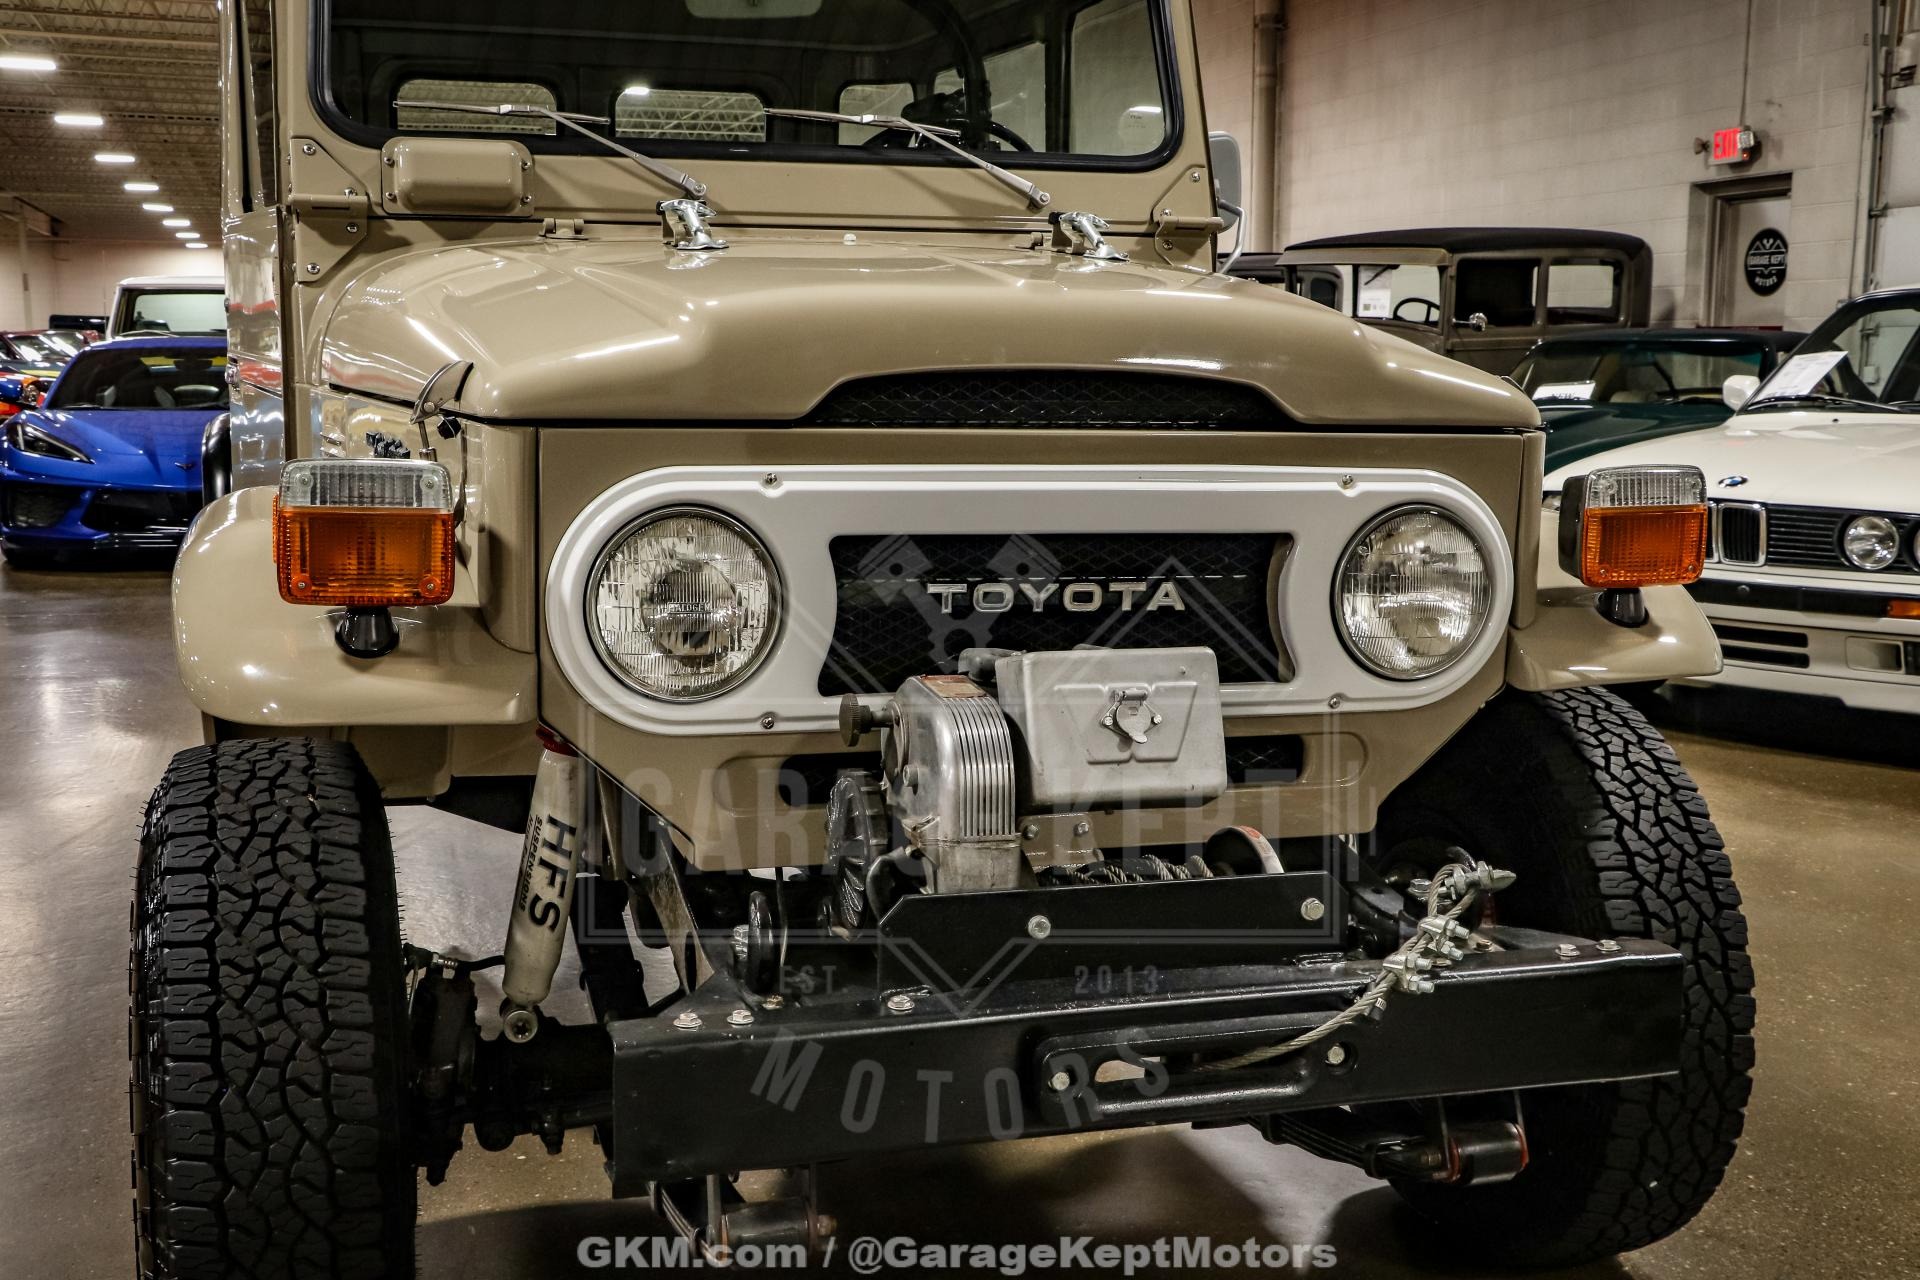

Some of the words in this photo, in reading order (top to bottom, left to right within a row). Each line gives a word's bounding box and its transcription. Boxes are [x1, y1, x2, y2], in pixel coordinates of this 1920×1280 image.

[1713, 128, 1741, 160] EXIT
[927, 582, 1186, 613] TOYOTA
[520, 814, 543, 912] SUSPENSIONS
[529, 814, 577, 932] HFS
